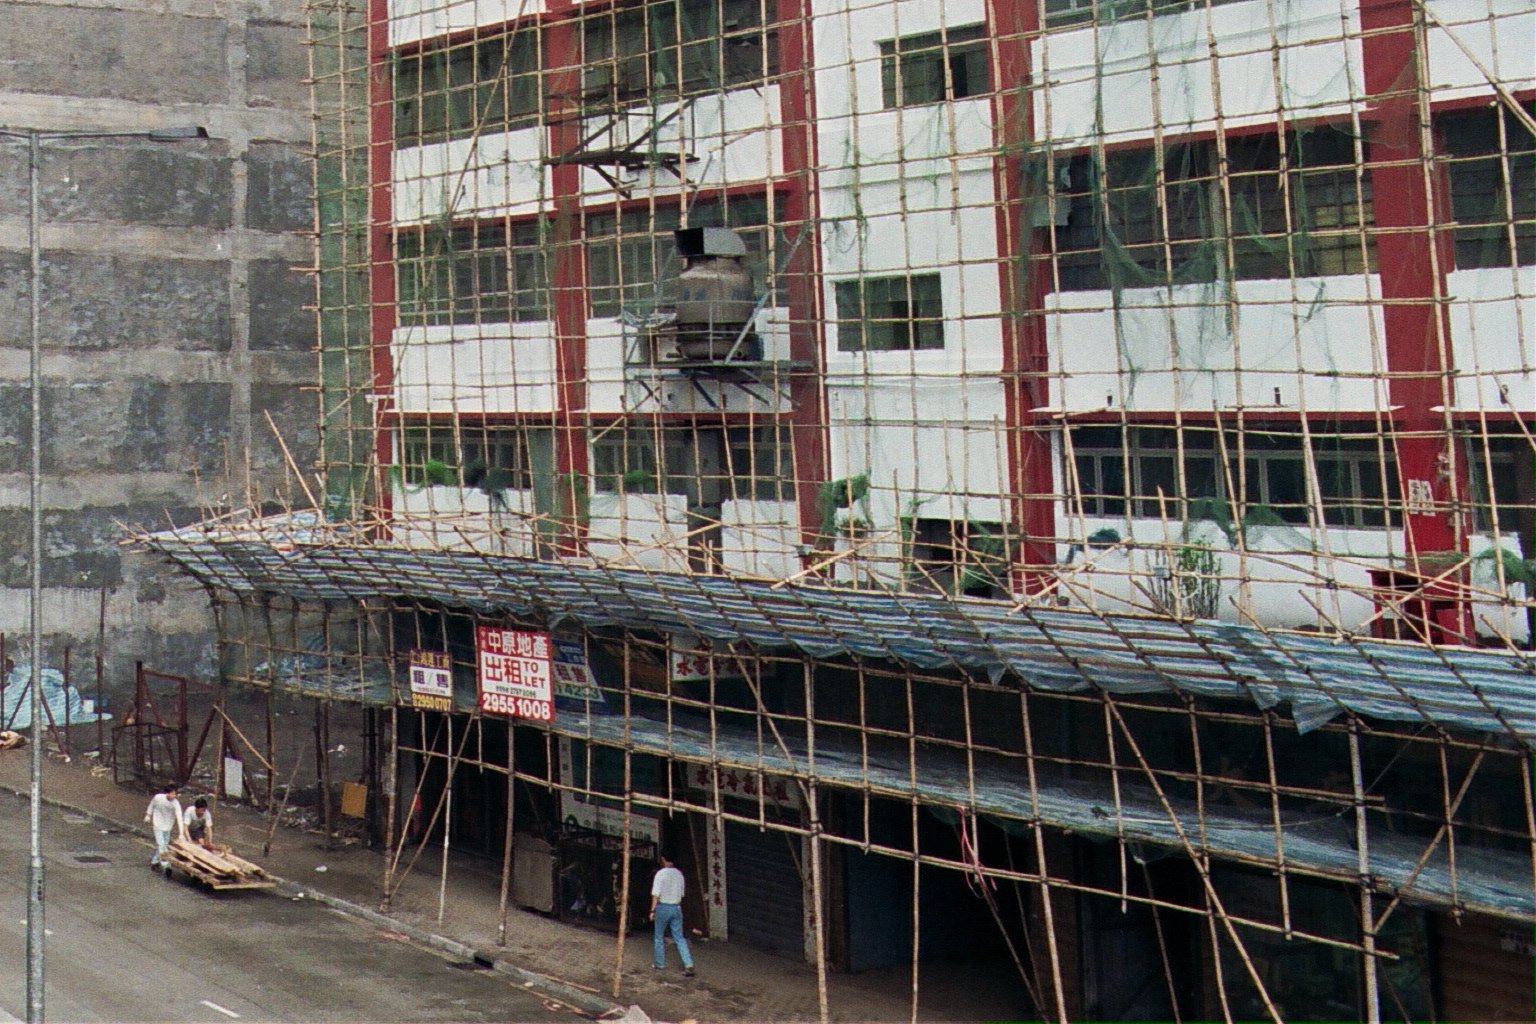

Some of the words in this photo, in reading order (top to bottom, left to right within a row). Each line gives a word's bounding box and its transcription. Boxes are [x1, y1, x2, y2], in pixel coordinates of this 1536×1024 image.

[488, 629, 549, 659] 中原地產
[485, 656, 522, 685] 出租
[523, 661, 539, 674] TO
[524, 676, 546, 689] LET
[482, 692, 516, 715] 2955
[516, 698, 551, 720] 1008
